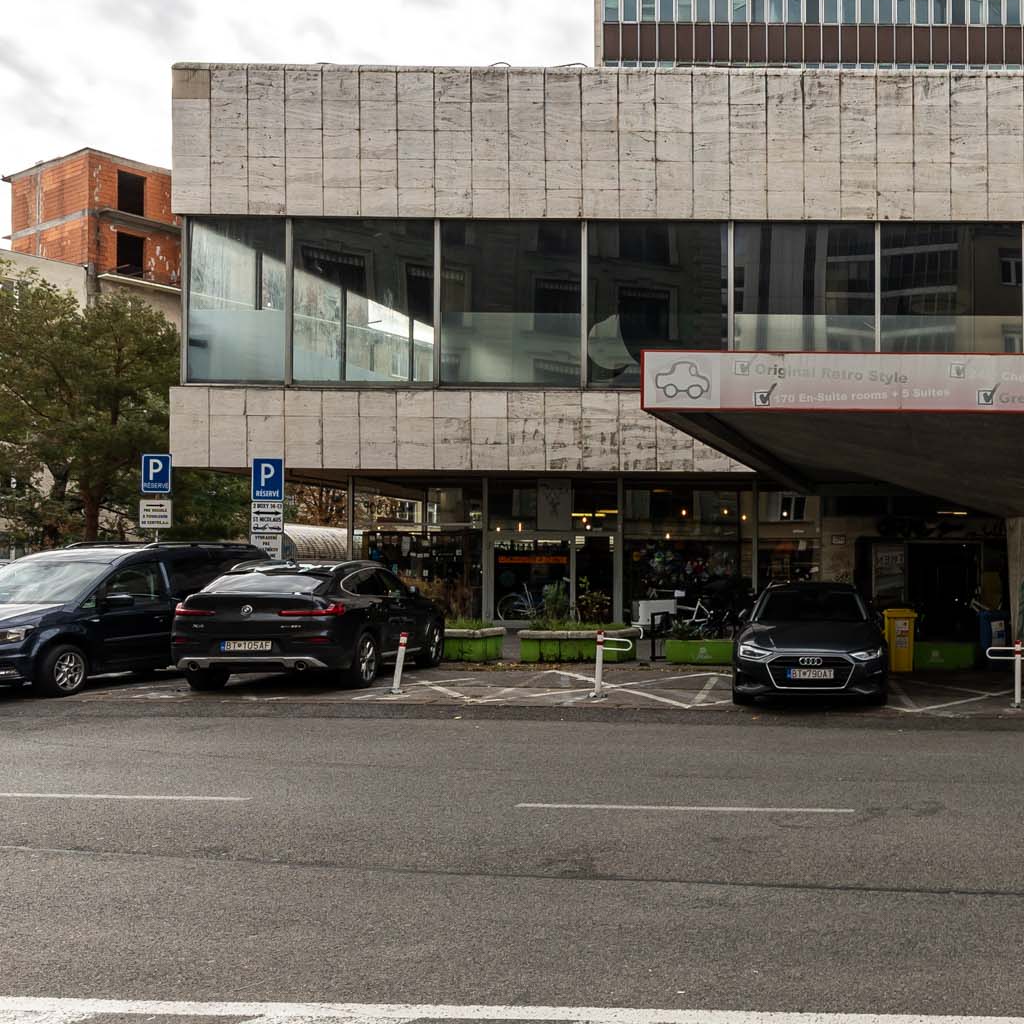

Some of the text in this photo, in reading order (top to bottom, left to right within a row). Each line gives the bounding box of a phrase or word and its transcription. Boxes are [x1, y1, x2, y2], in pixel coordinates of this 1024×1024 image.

[755, 363, 908, 385] Original Retro Style
[851, 390, 888, 401] rooms
[149, 458, 163, 481] P
[260, 463, 275, 487] P
